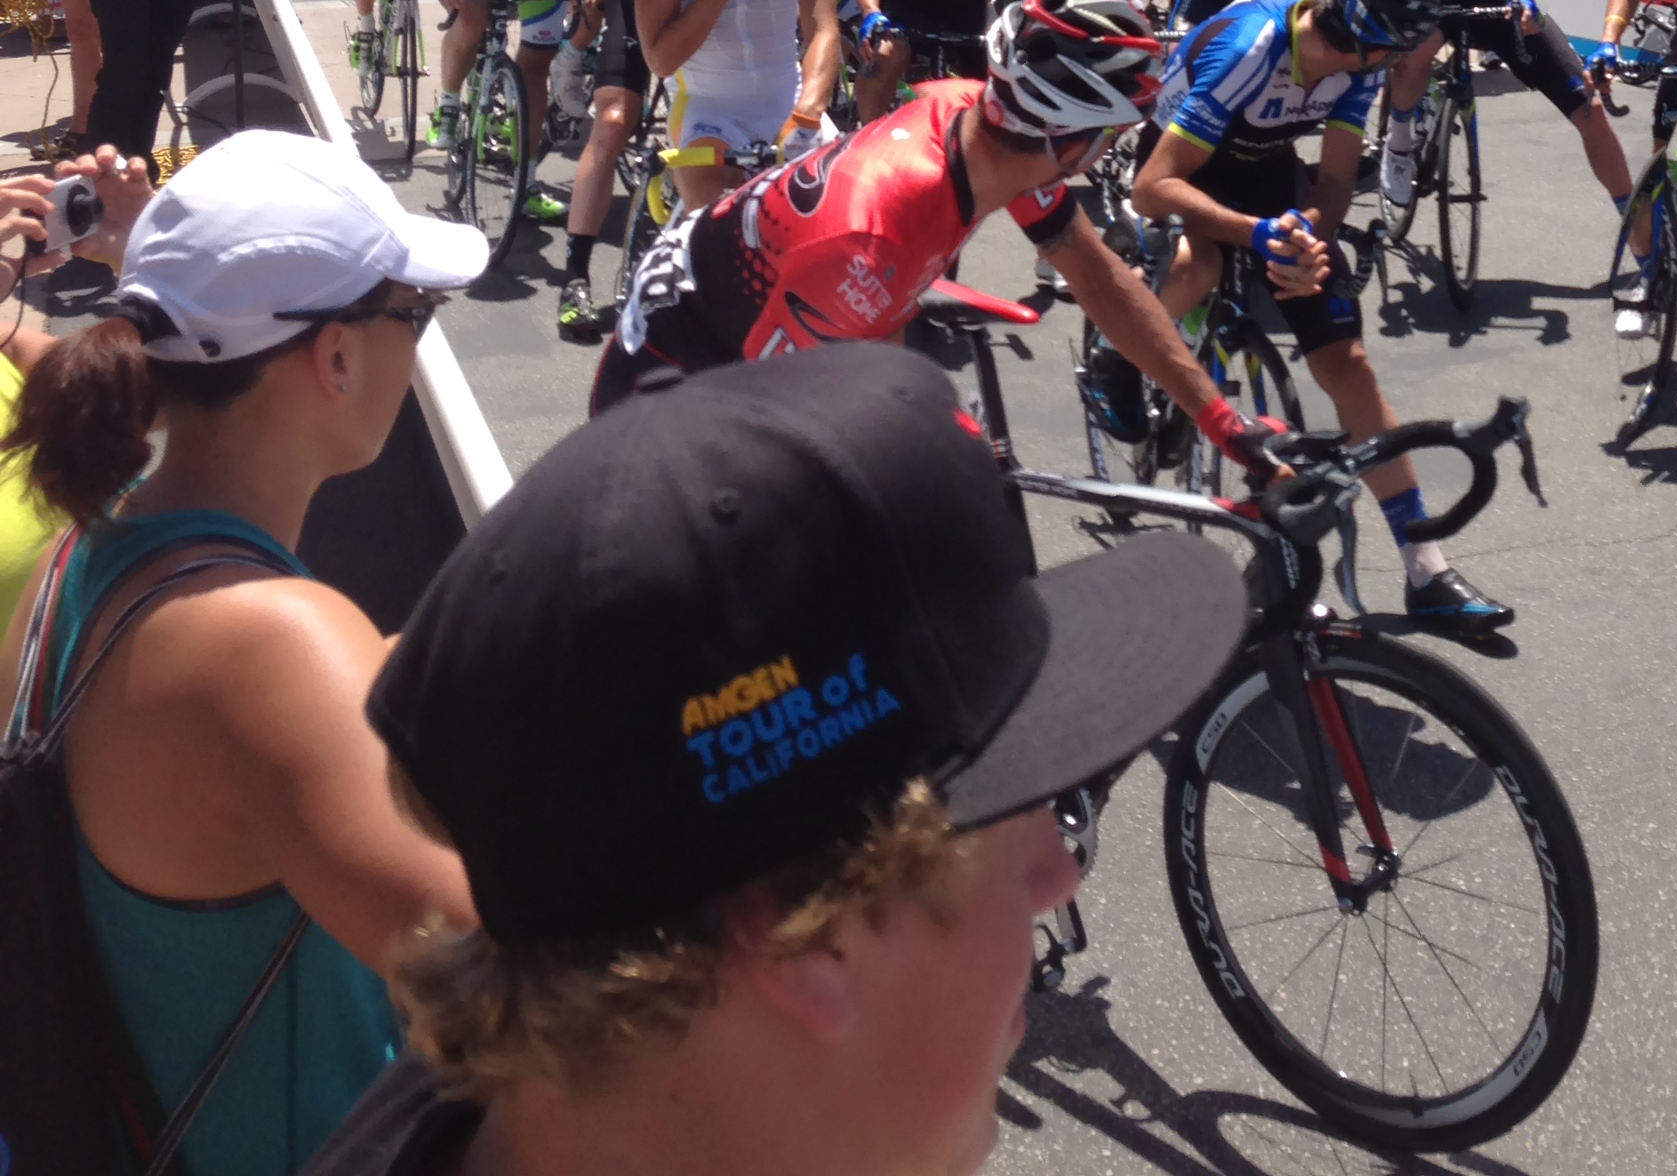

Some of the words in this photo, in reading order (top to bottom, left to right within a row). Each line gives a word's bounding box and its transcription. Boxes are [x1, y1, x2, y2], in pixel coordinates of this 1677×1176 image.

[683, 655, 798, 735] AMGEN
[687, 687, 816, 767] TOUR
[822, 653, 867, 707] of
[703, 688, 901, 802] CALIFORNIA
[1496, 762, 1565, 1002] DURA-ACE
